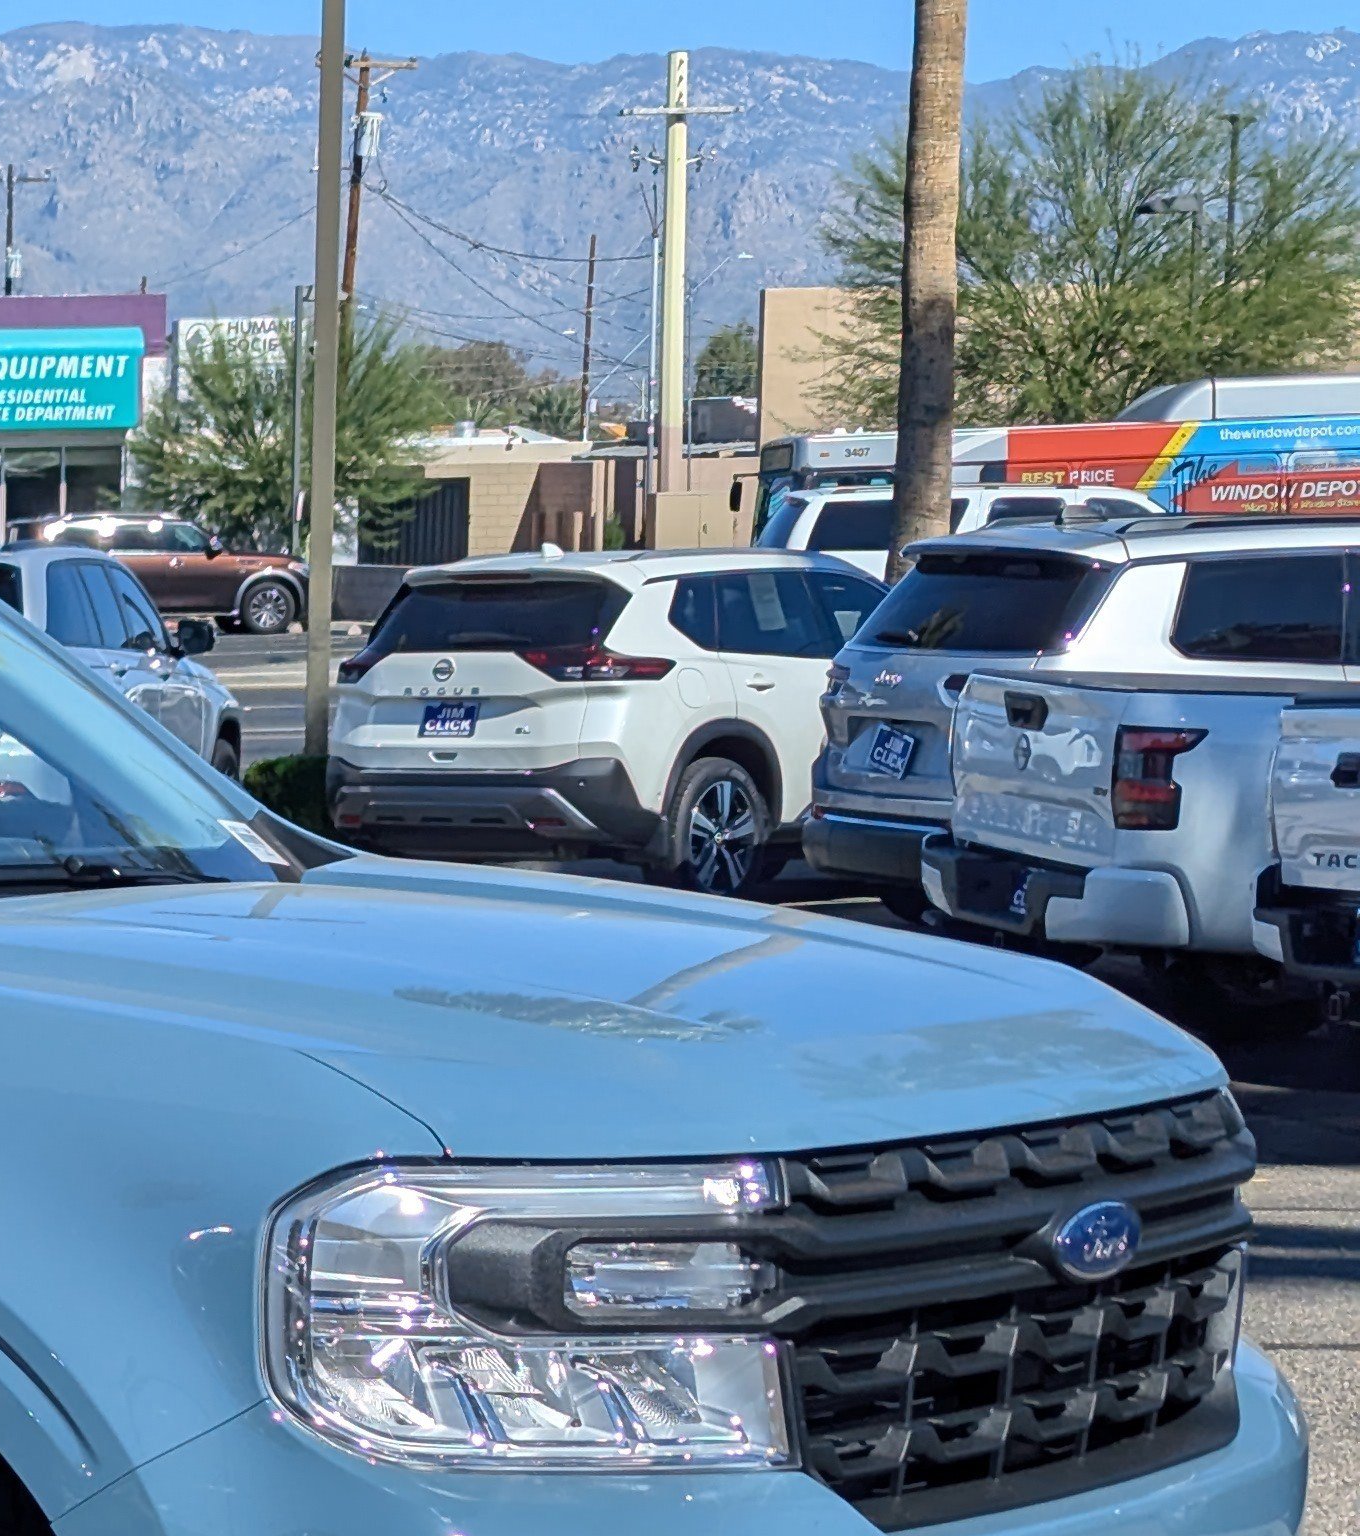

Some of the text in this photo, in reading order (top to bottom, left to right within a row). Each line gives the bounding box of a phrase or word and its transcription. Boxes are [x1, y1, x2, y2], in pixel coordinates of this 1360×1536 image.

[224, 338, 280, 353] SOCIE
[14, 404, 116, 422] DEPARTMENT
[844, 447, 871, 458] 3407
[1069, 469, 1115, 484] PRICE
[1300, 480, 1360, 498] DEPO
[436, 707, 465, 719] JIM
[425, 719, 472, 731] CLICK
[873, 746, 906, 771] CLICK
